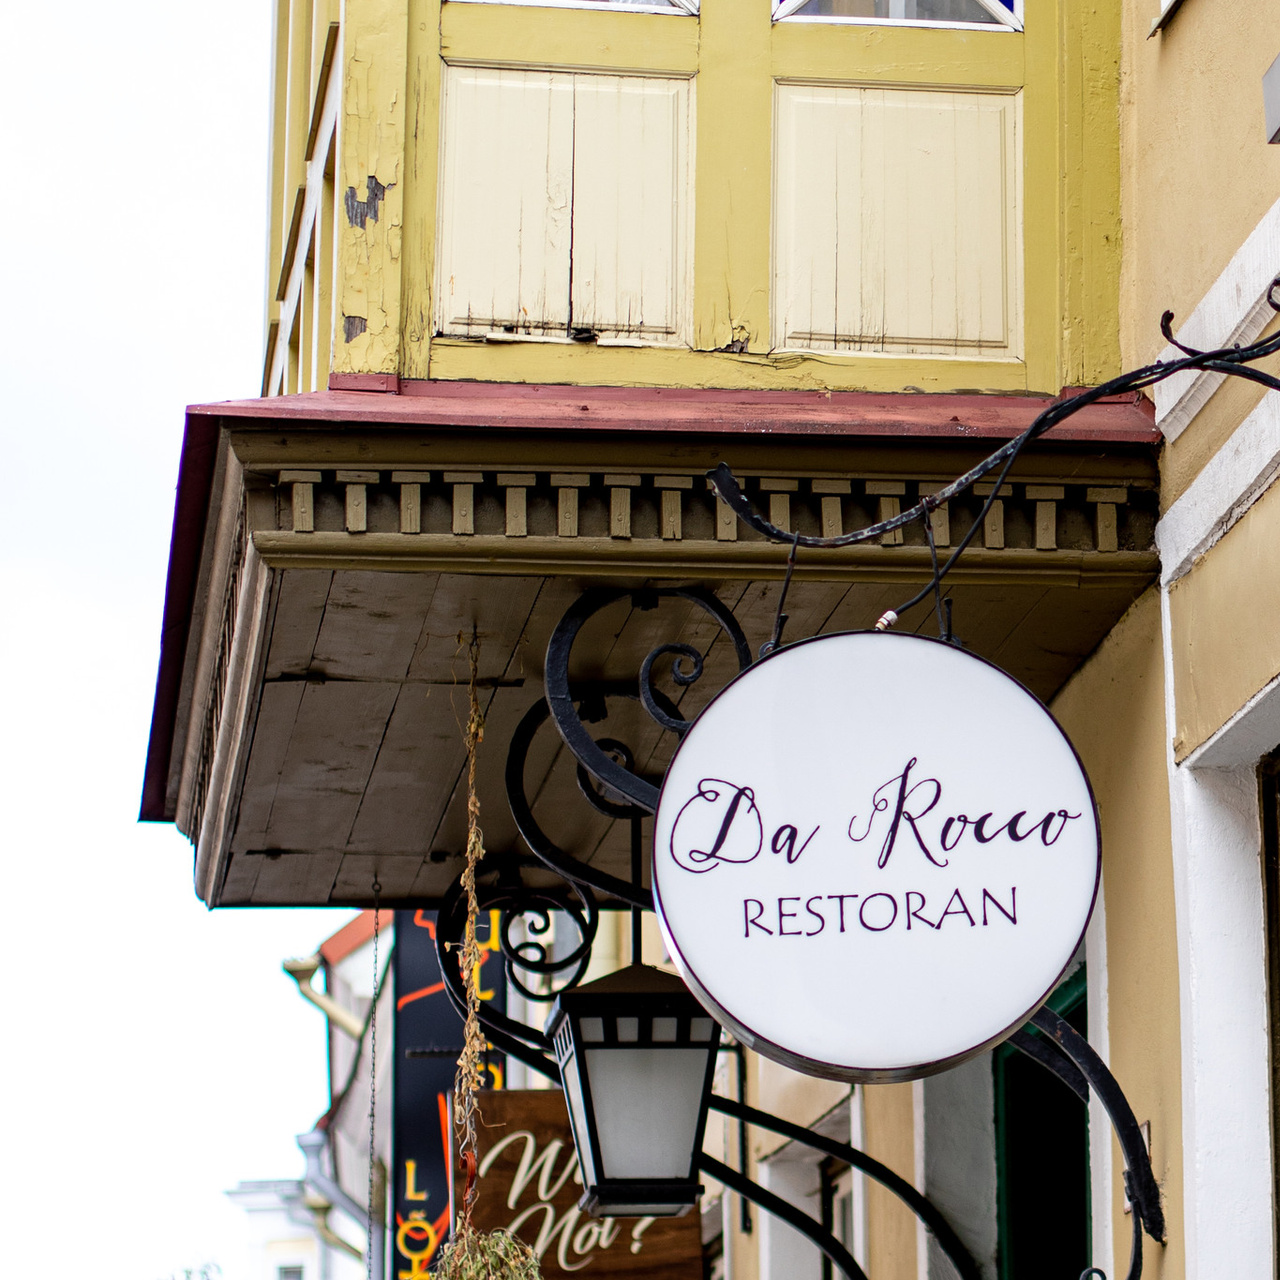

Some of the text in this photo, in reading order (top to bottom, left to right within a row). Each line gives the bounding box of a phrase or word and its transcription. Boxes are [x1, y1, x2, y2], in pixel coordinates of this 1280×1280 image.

[670, 757, 1082, 873] Da Rocco
[743, 886, 1018, 938] RESTORAN
